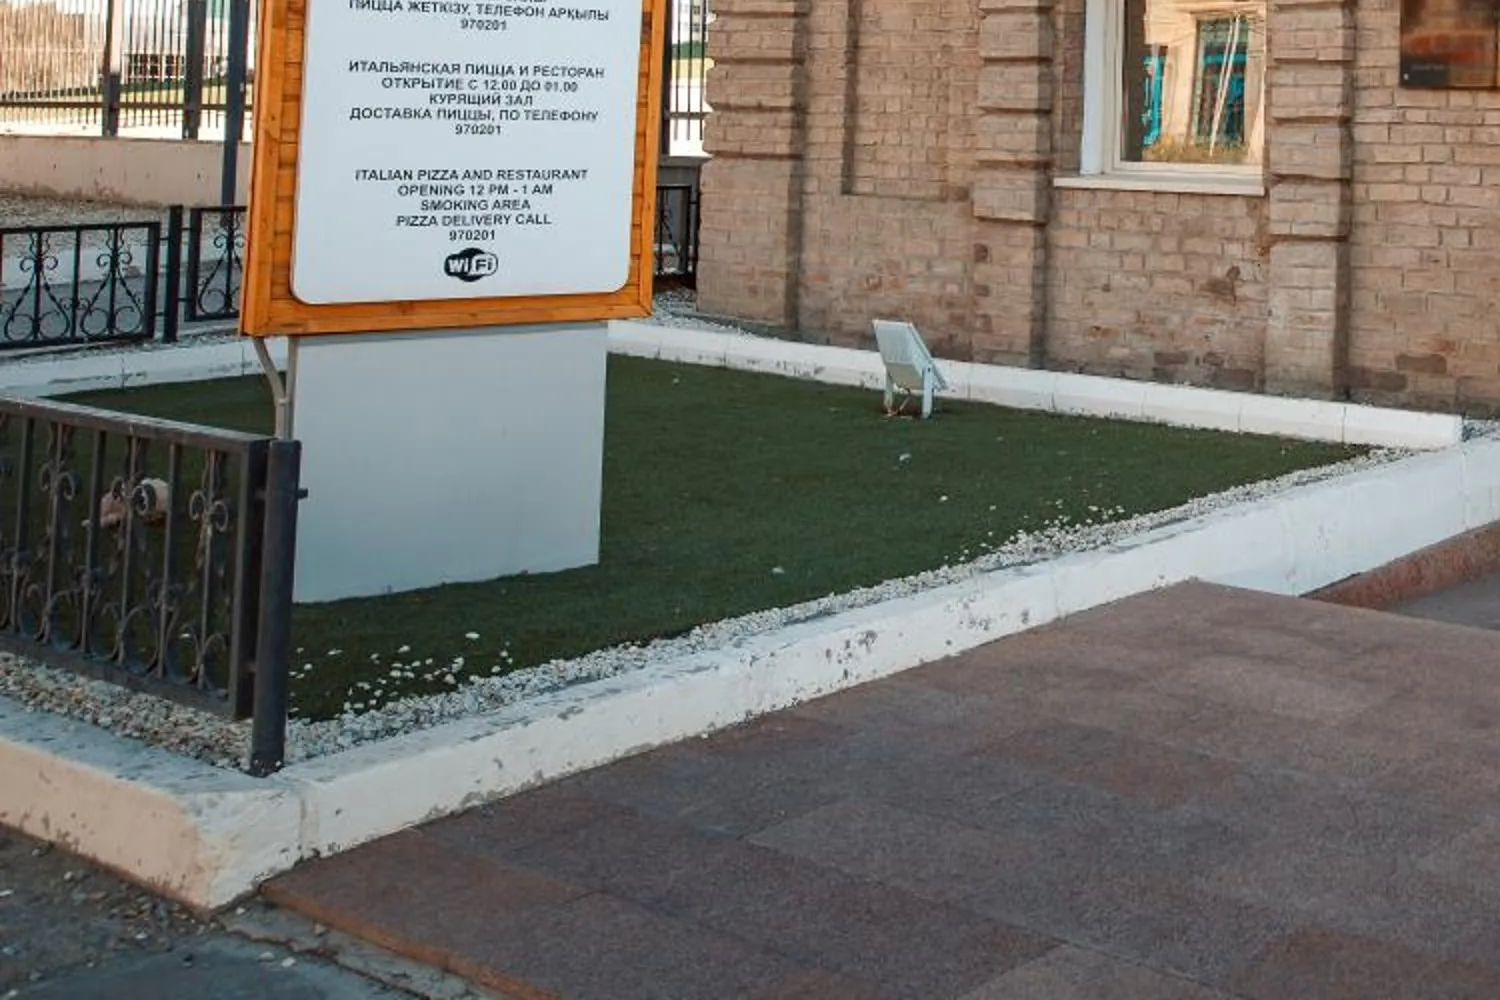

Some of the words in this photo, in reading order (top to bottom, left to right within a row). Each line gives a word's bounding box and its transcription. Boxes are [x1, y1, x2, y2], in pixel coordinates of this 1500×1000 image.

[476, 3, 545, 18] ТЕЛЕФОН
[460, 19, 507, 31] 970201
[349, 60, 461, 74] ИТАЛЬЯНСКАЯ
[465, 63, 515, 77] ПИЦЦА
[519, 66, 529, 76] И
[533, 66, 605, 78] РЕСТОРАН
[381, 77, 464, 90] ОТКРЫТИЕ
[468, 79, 478, 90] С
[520, 80, 541, 92] ДО
[429, 91, 501, 106] КУРЯЩИЙ
[505, 94, 533, 106] ЗАЛ
[350, 107, 432, 121] ДОСТАВКА
[500, 109, 521, 121] ПО
[524, 110, 599, 122] ТЕЛЕФОНУ
[455, 123, 502, 135] 970201
[355, 169, 413, 181] ITALIAN
[417, 169, 459, 181] PIZZA
[461, 169, 493, 180] AND
[497, 169, 588, 180] RESTAURANT
[397, 184, 465, 196] OPENING
[470, 184, 485, 195] 12
[489, 184, 509, 195] PM
[531, 184, 553, 195] AM
[420, 199, 489, 211] SMOKING
[491, 199, 531, 211] AREA
[396, 214, 439, 227] PIZZA
[442, 214, 512, 227] DELIVERY
[515, 213, 553, 225] CALL
[449, 229, 496, 241] 970201
